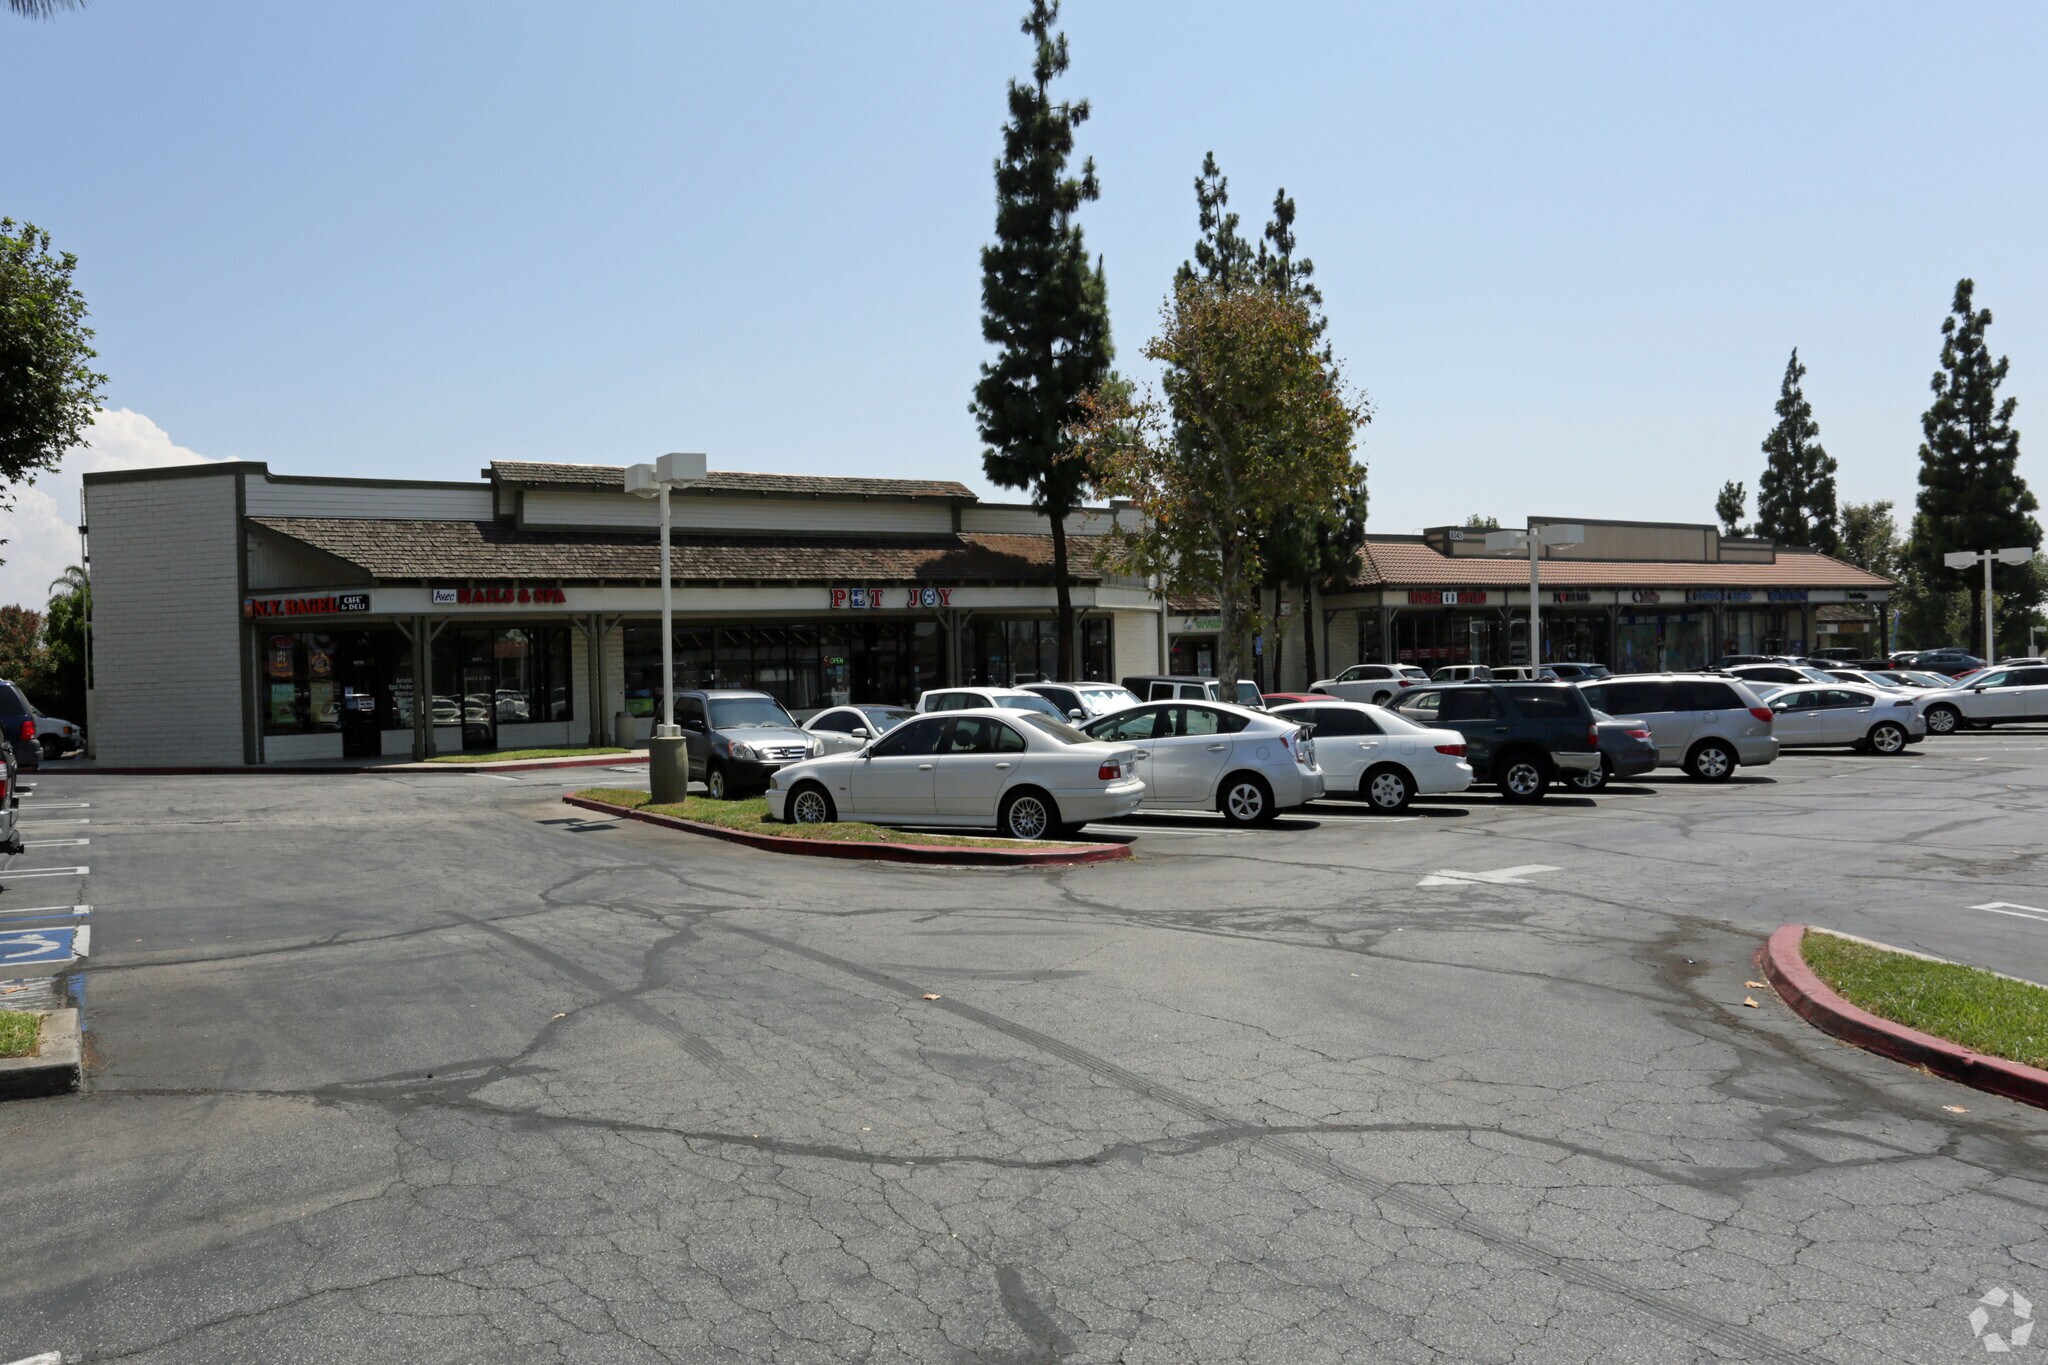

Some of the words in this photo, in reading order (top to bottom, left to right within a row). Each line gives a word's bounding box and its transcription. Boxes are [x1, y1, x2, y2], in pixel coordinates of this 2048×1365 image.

[435, 590, 454, 602] Avec
[458, 588, 515, 604] NAILS
[517, 588, 531, 604] &
[533, 588, 567, 604] SPA
[831, 588, 884, 608] PET
[908, 588, 953, 608] JOY
[253, 600, 284, 616] N.Y.
[284, 597, 339, 616] BAGEL
[349, 603, 366, 611] DELI
[830, 656, 844, 665] OPEN
